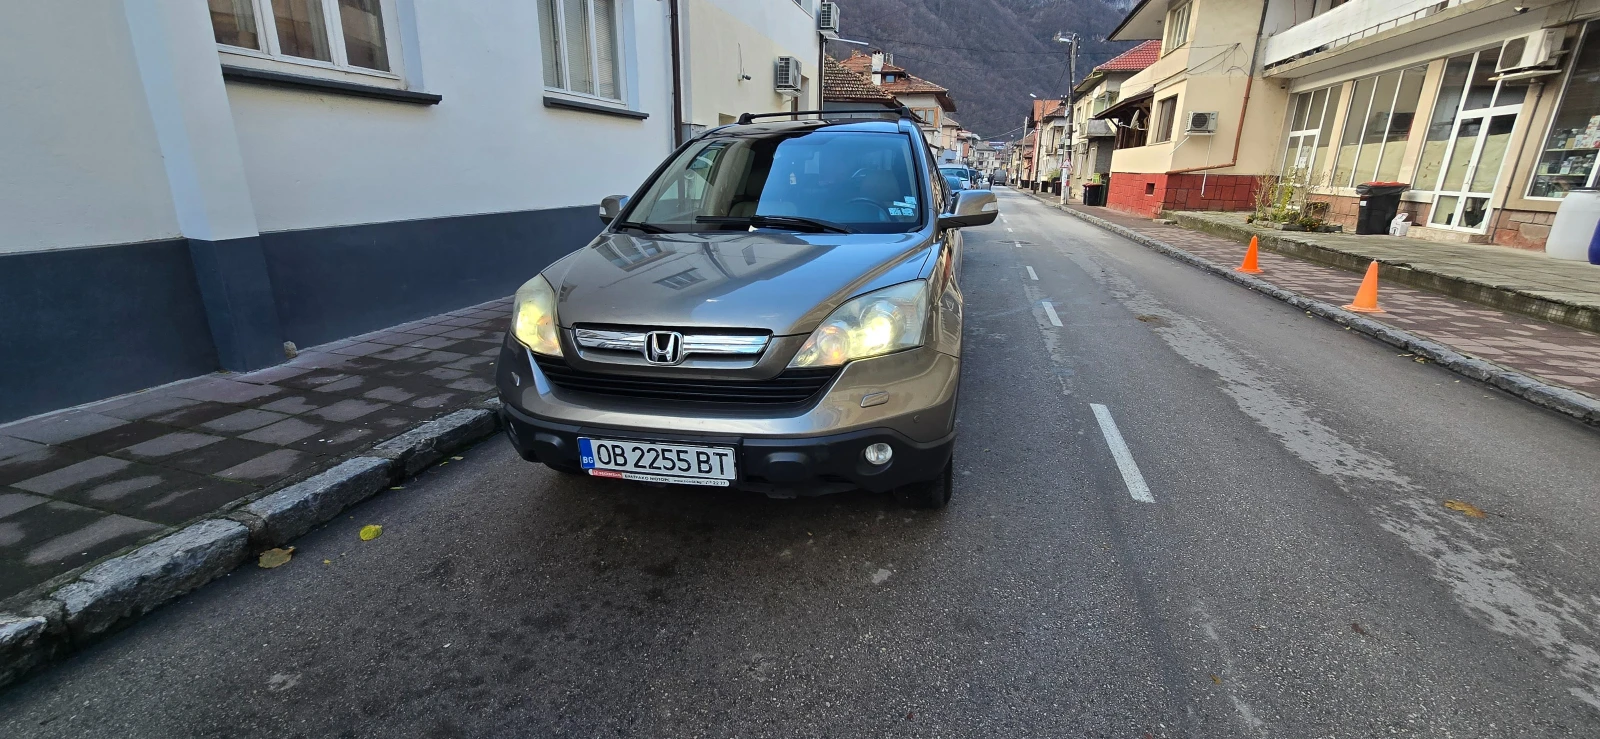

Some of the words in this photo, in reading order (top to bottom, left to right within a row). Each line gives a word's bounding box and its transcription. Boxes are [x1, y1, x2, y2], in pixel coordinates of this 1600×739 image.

[596, 444, 628, 466] OB
[631, 446, 692, 472] 2255
[696, 450, 729, 476] BT
